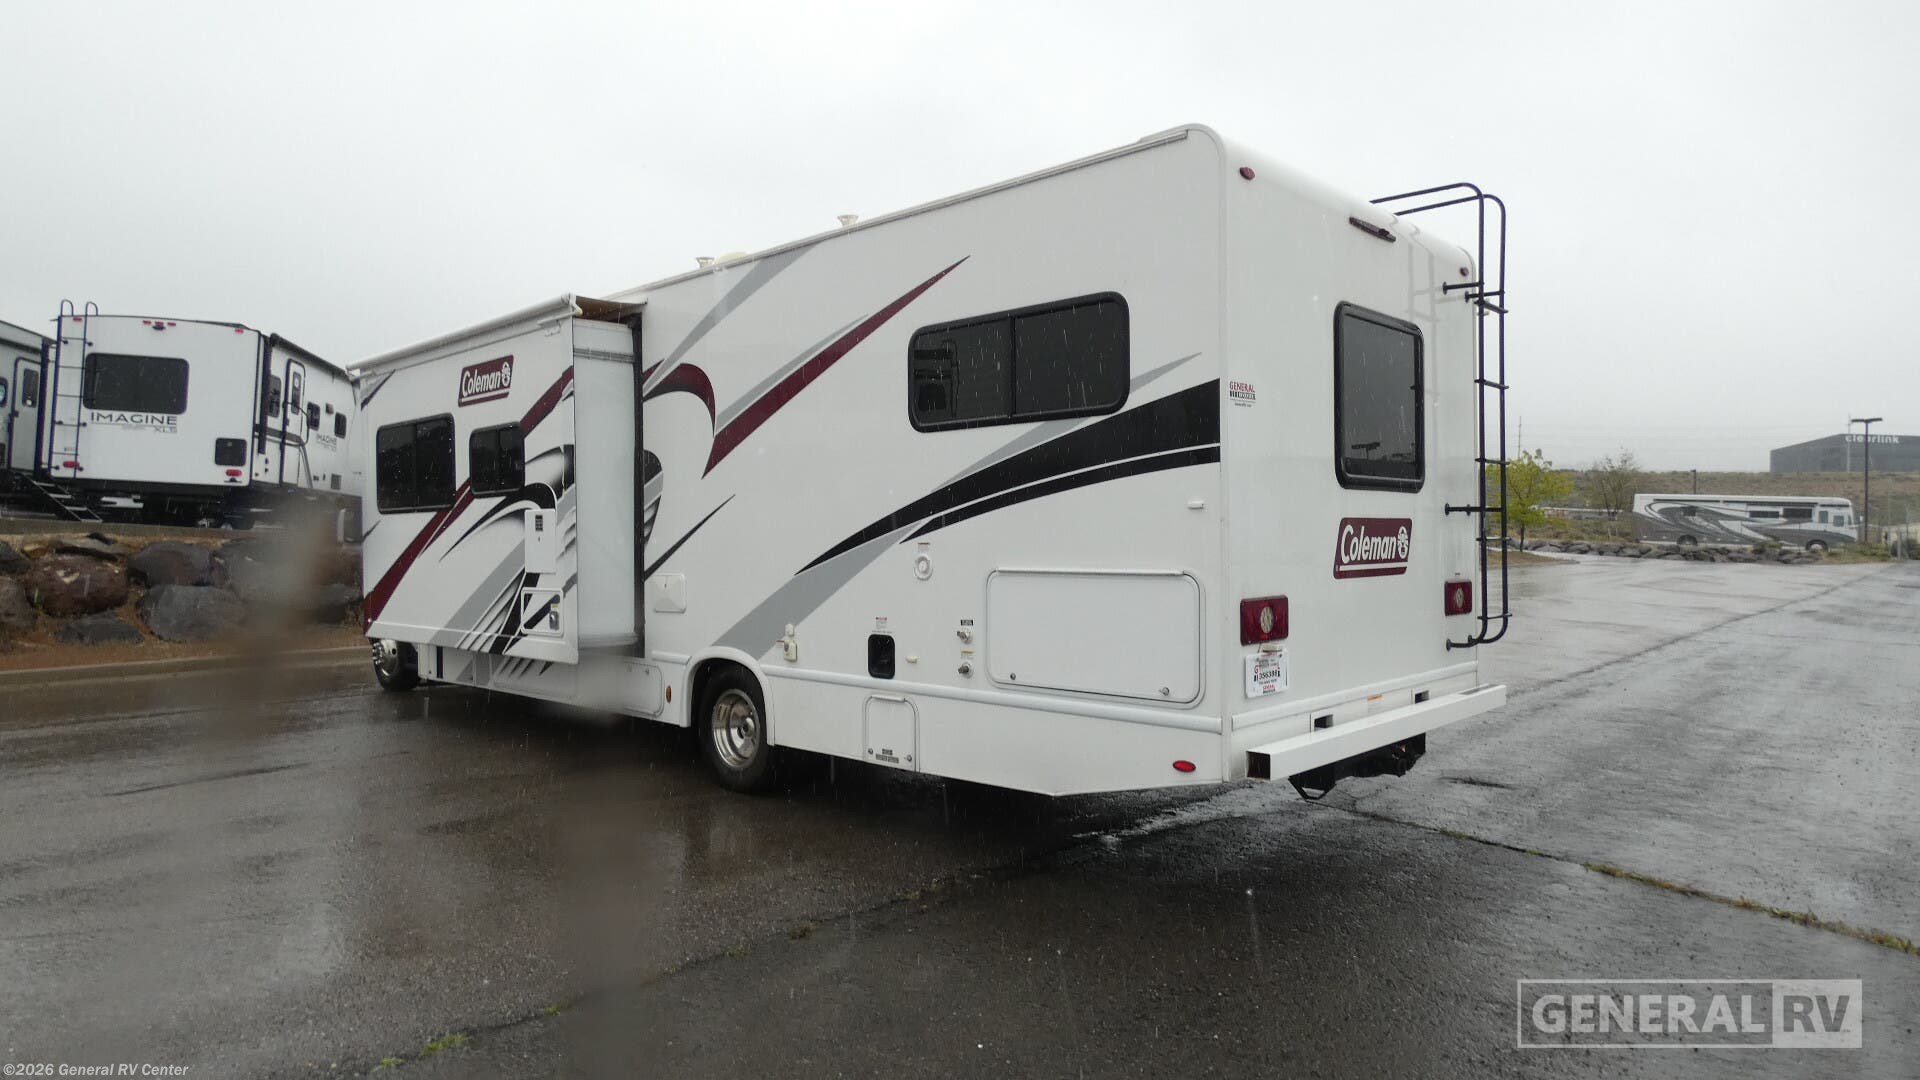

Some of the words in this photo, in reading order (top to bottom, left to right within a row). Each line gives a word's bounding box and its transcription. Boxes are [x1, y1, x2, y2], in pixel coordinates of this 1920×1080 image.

[462, 368, 501, 398] Coleman
[91, 411, 177, 426] IMAGINE
[1340, 524, 1397, 564] Coleman
